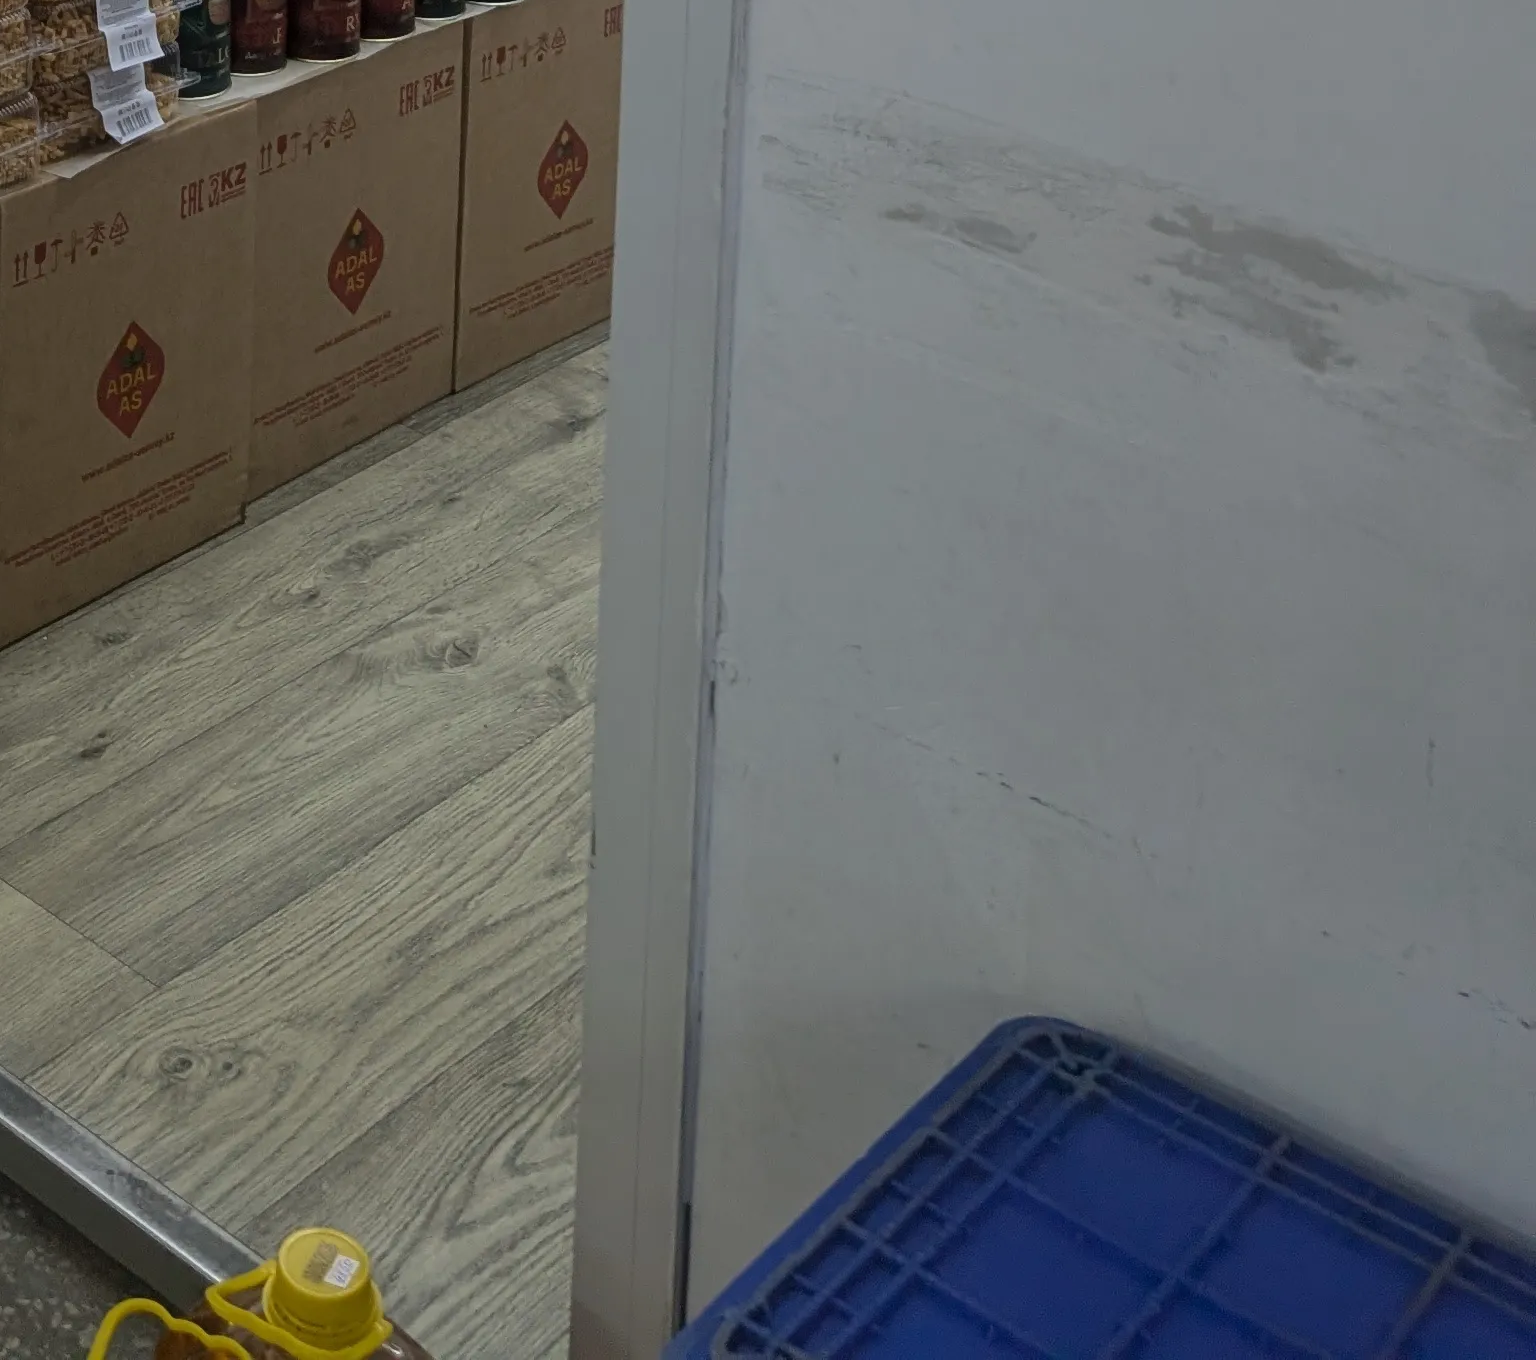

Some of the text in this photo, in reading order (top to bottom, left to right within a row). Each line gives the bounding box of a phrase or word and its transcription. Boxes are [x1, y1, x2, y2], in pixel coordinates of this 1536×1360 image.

[543, 157, 584, 184] ADAL
[551, 179, 572, 201] AS
[335, 249, 378, 280] ADAL
[345, 273, 366, 295] AS
[106, 361, 157, 399] ADAL
[118, 390, 143, 417] AS
